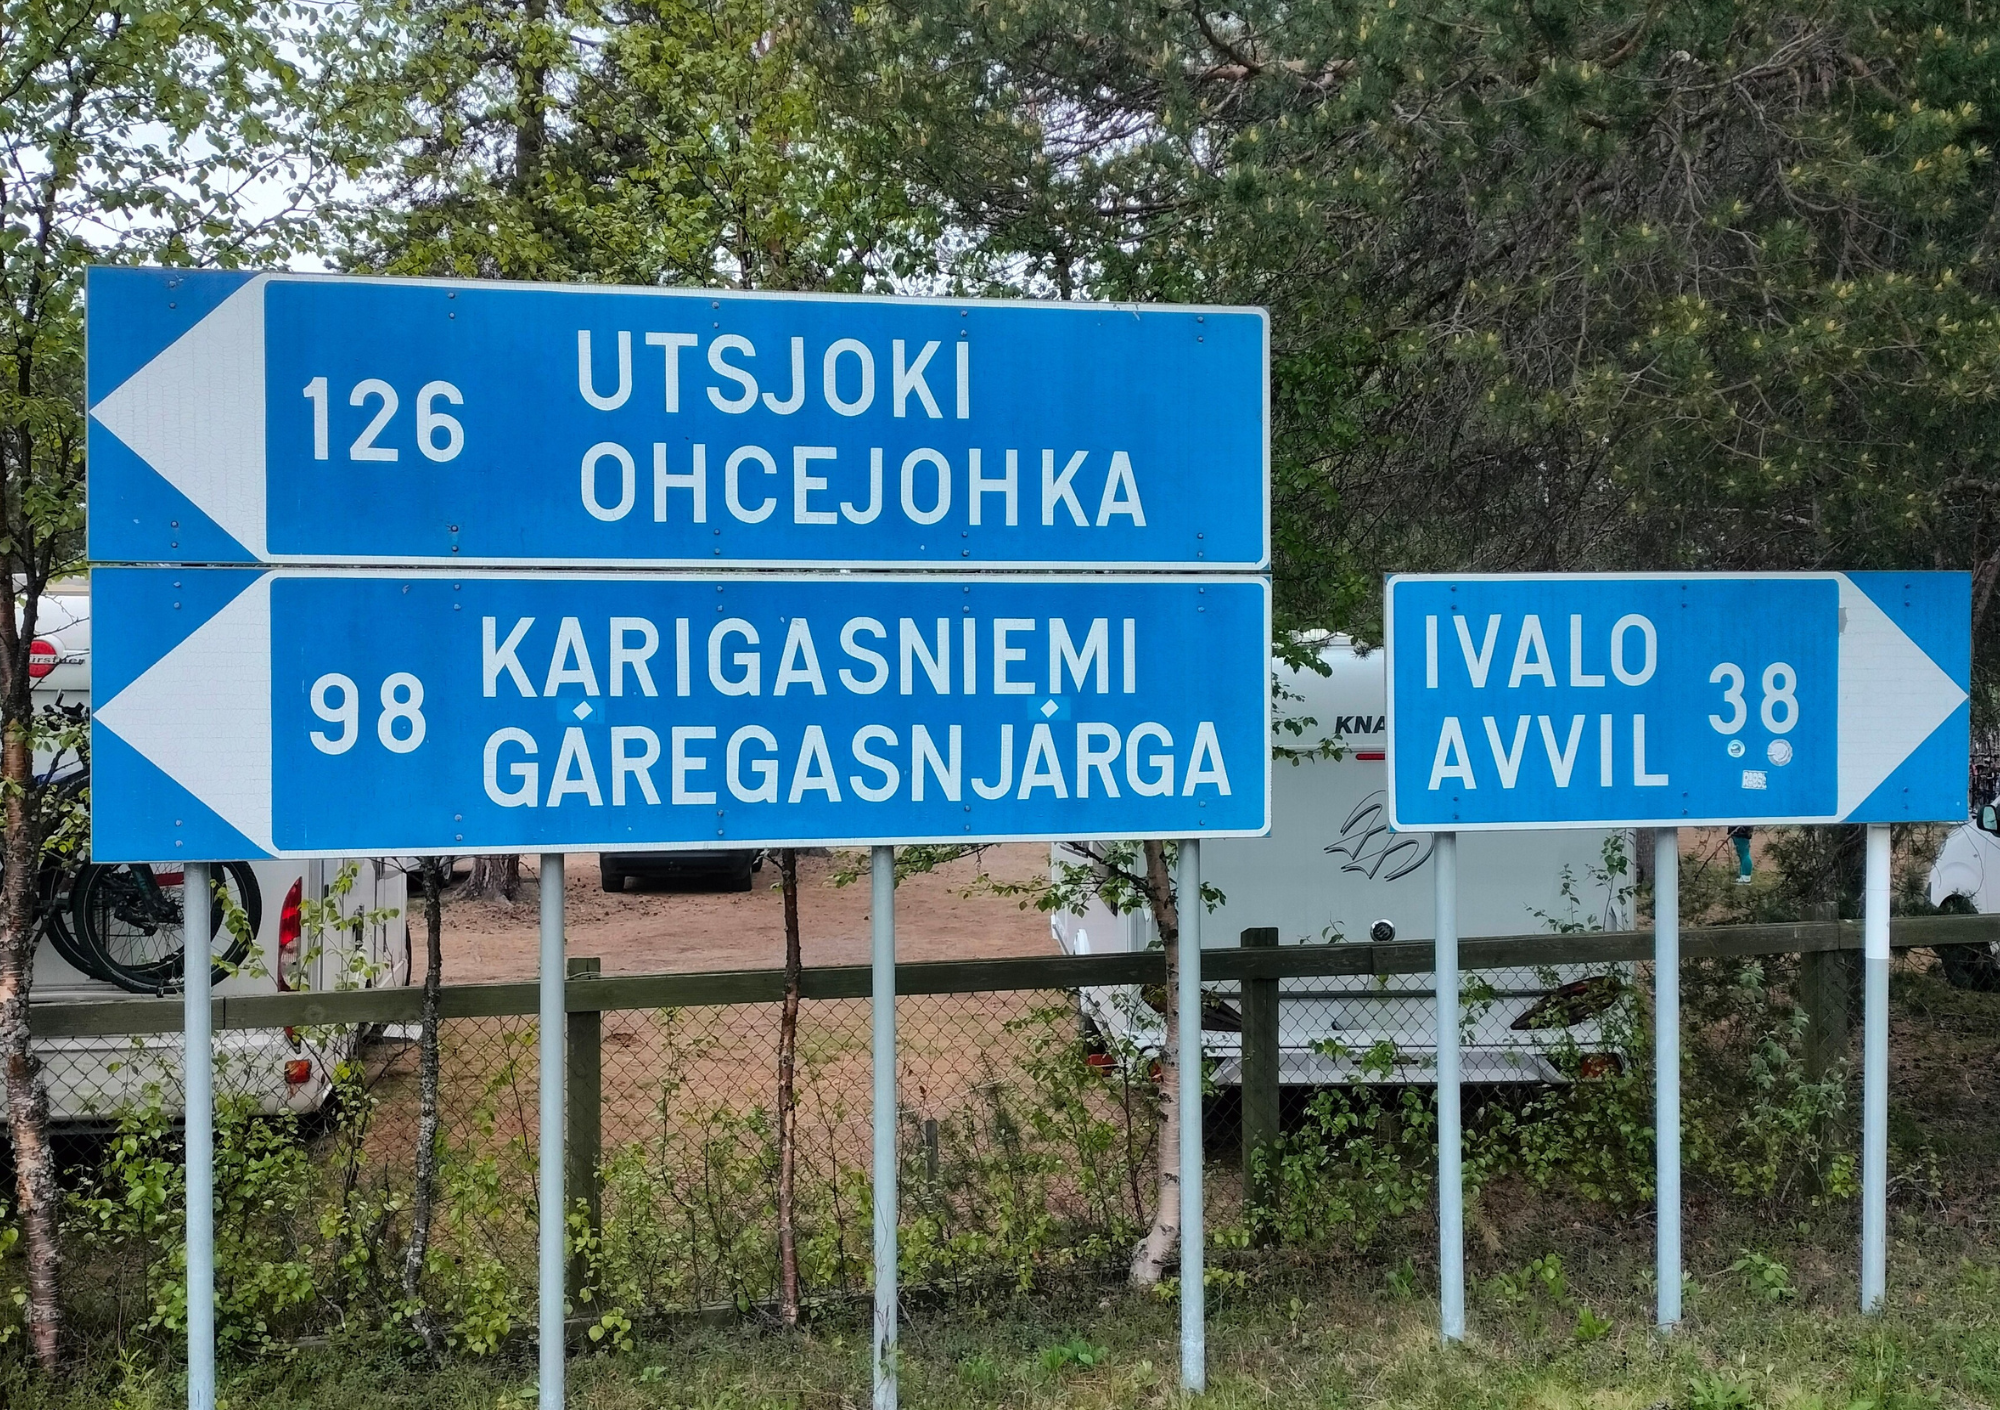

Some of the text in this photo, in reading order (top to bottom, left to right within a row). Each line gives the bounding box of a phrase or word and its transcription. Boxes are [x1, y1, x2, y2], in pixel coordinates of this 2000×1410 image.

[577, 330, 970, 419] UTSJOKI
[302, 377, 465, 462] 126
[580, 442, 1147, 527] OHCEJOHKA
[482, 616, 1136, 698] KARIGASNIEMI
[1426, 614, 1657, 689] IVALO
[309, 672, 426, 756] 98
[1708, 662, 1799, 735] 38
[1428, 714, 1669, 790] AVVIL
